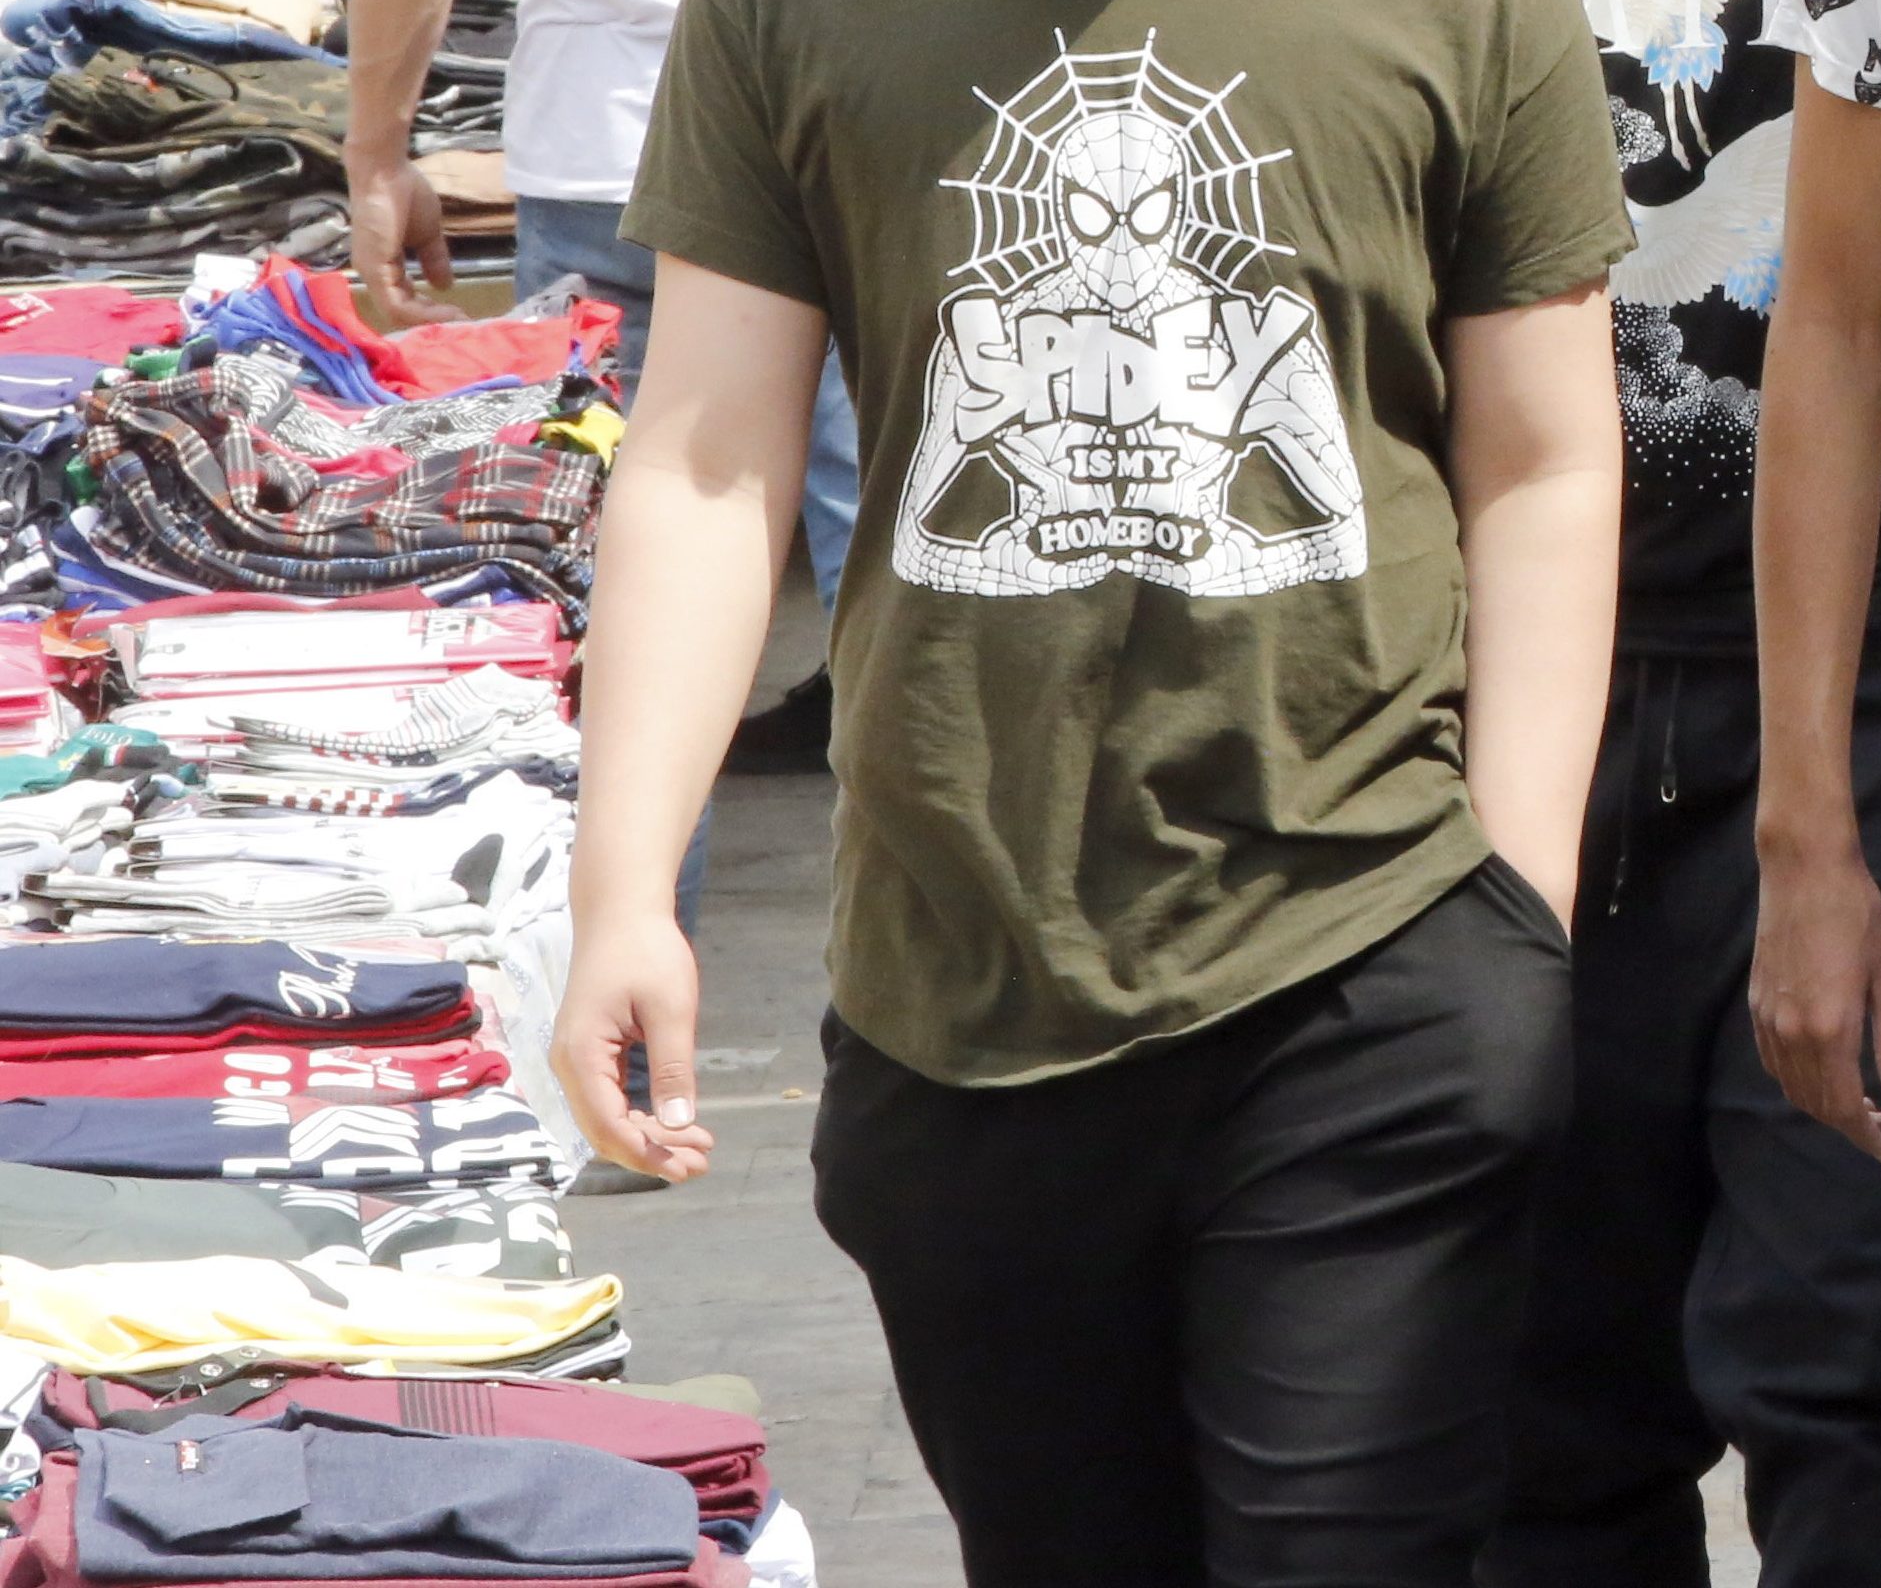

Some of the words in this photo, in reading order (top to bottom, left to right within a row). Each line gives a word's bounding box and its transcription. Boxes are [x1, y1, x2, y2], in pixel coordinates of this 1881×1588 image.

[953, 296, 1313, 445] SPIDEY
[1071, 448, 1112, 478] IS
[1117, 447, 1177, 478] MY
[1040, 516, 1203, 557] HOMEBOY
